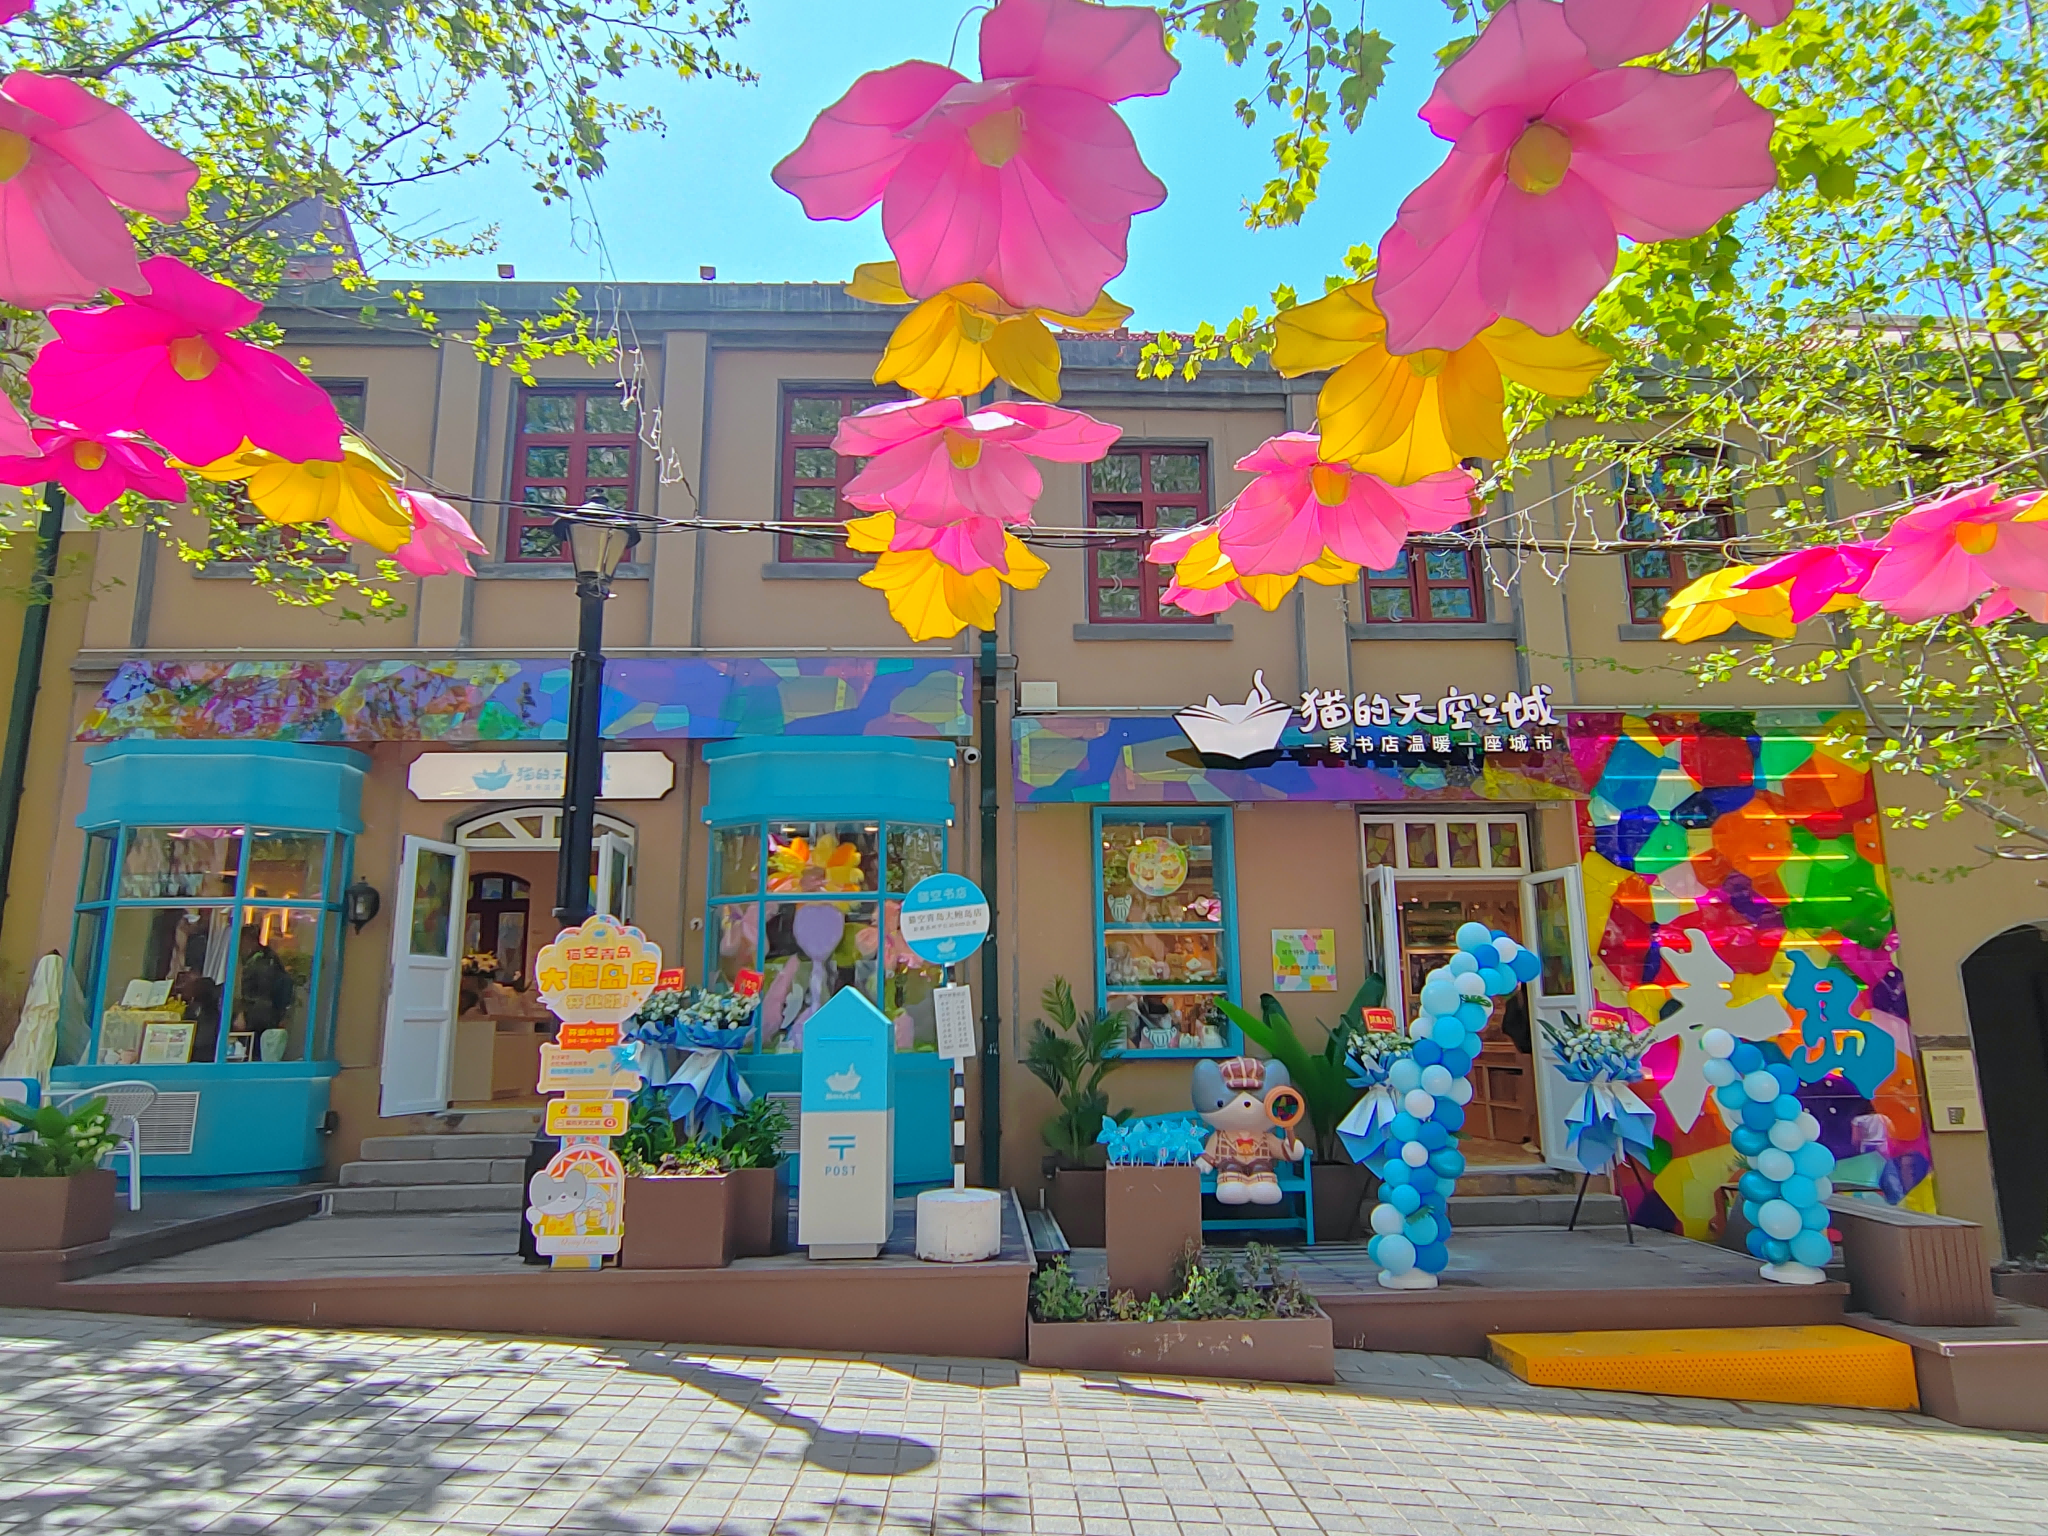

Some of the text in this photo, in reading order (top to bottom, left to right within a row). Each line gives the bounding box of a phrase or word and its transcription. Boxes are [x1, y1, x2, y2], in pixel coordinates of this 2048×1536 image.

[1299, 684, 1560, 733] 猫的天空之城
[1304, 734, 1553, 754] 一家书店温暖一座城市
[566, 946, 631, 961] 猫空青岛
[539, 960, 658, 992] 大鲍岛店
[824, 1165, 857, 1177] POST
